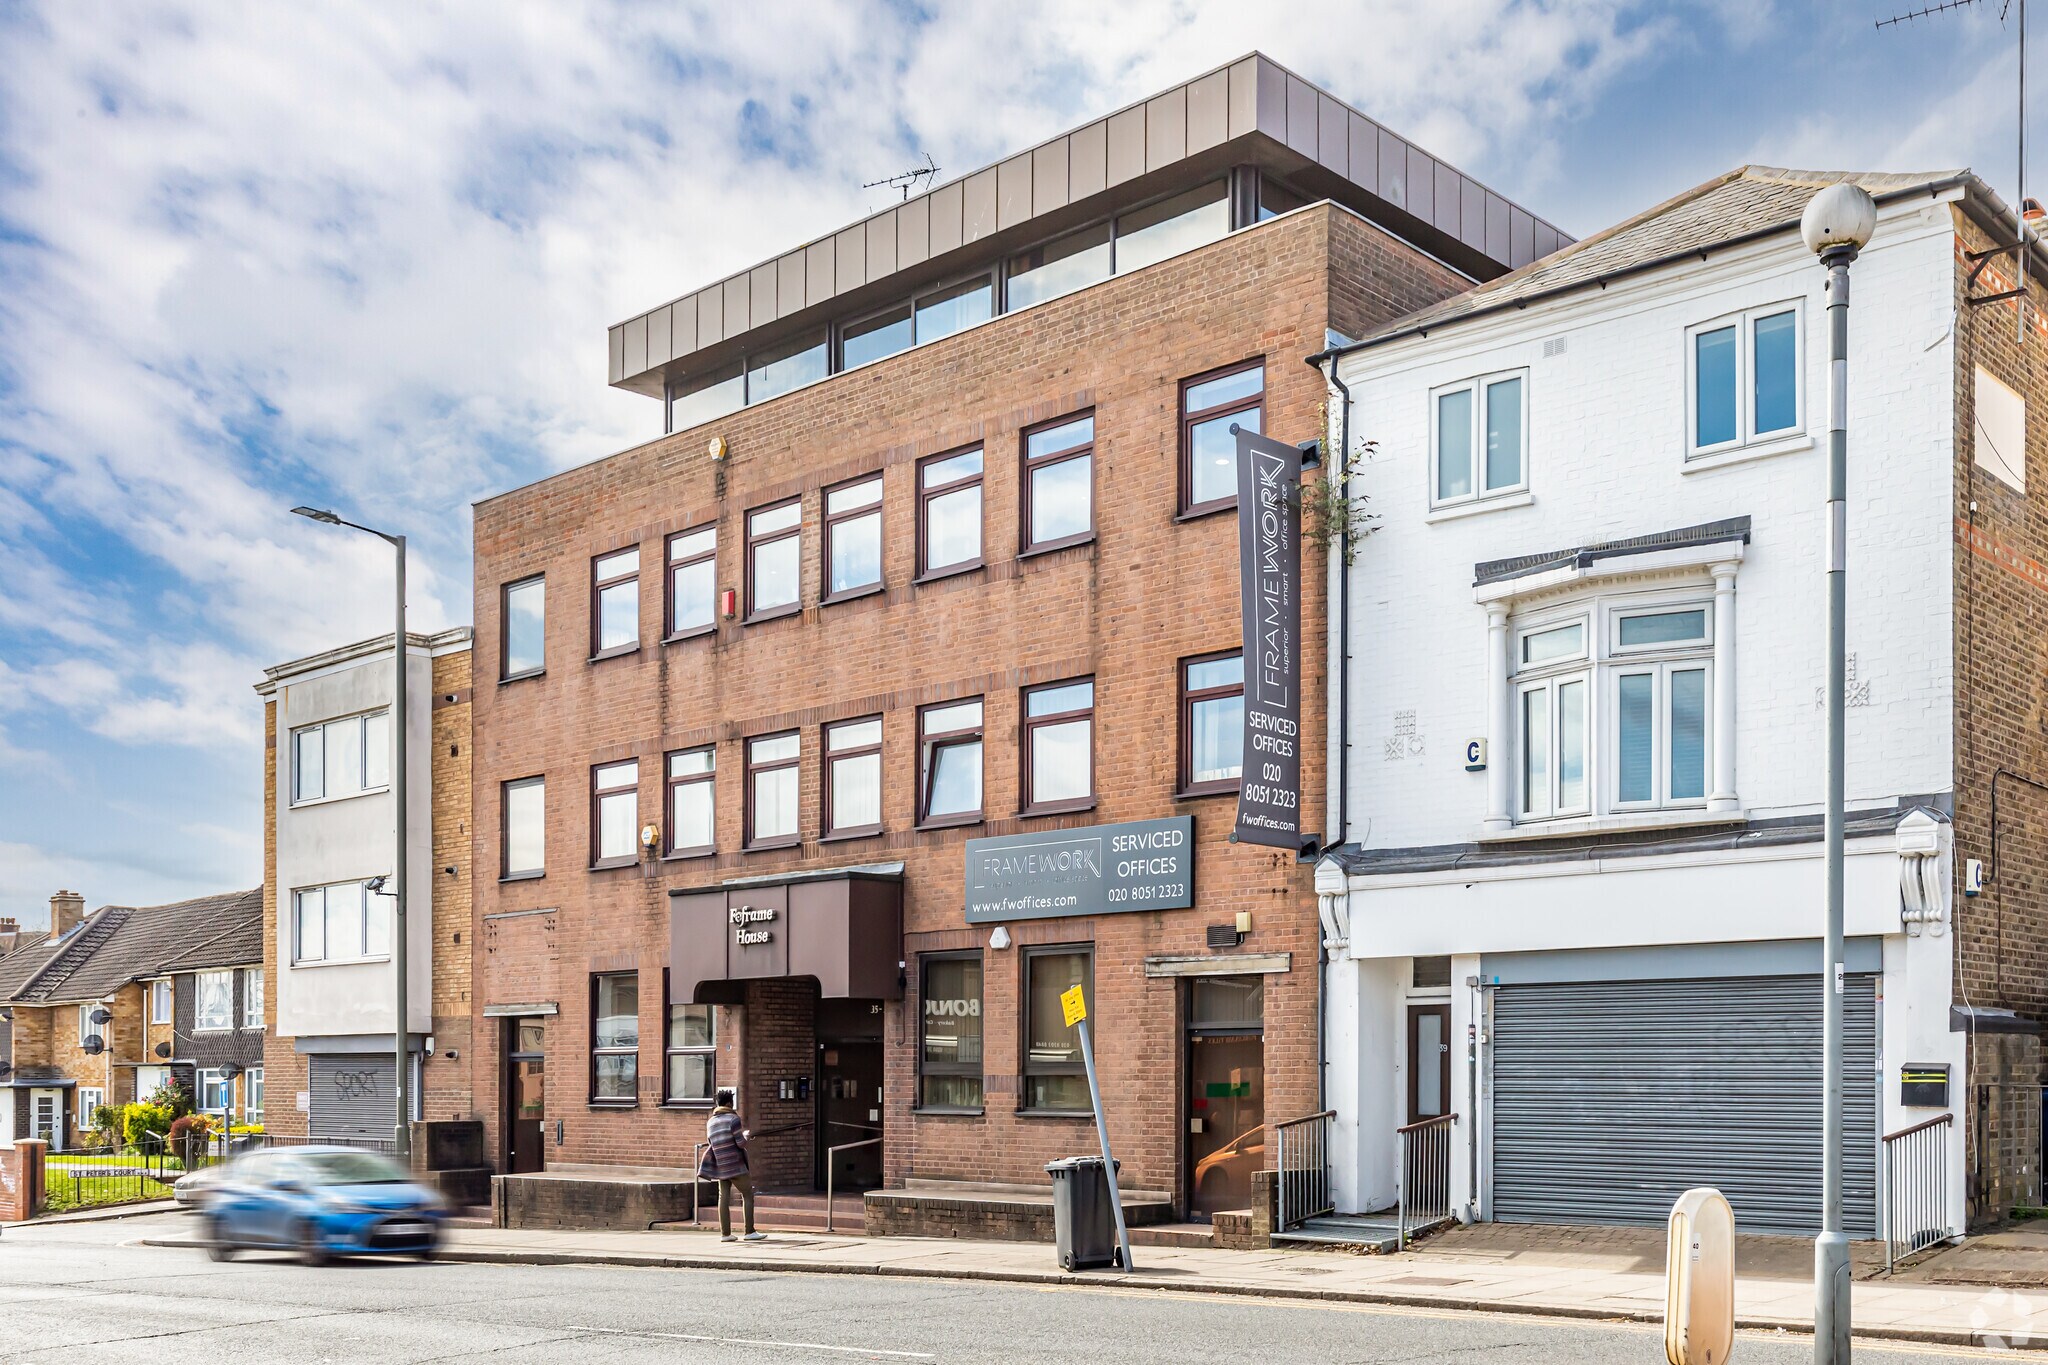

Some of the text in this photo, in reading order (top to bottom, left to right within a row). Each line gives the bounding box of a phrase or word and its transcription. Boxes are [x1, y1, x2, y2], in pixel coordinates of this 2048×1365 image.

[1249, 710, 1297, 737] SERVICED
[1253, 733, 1293, 758] OFFICES
[1262, 762, 1281, 782] 020
[1245, 783, 1296, 809] 8051 2323
[1242, 812, 1295, 832] fwoffices.com
[1112, 829, 1183, 852] SERVICED
[1117, 856, 1177, 878] OFFICES
[1108, 883, 1184, 902] 020 8051 2323
[972, 894, 1077, 913] www.fwoffices.com
[736, 929, 769, 944] House
[1439, 1043, 1448, 1053] 39
